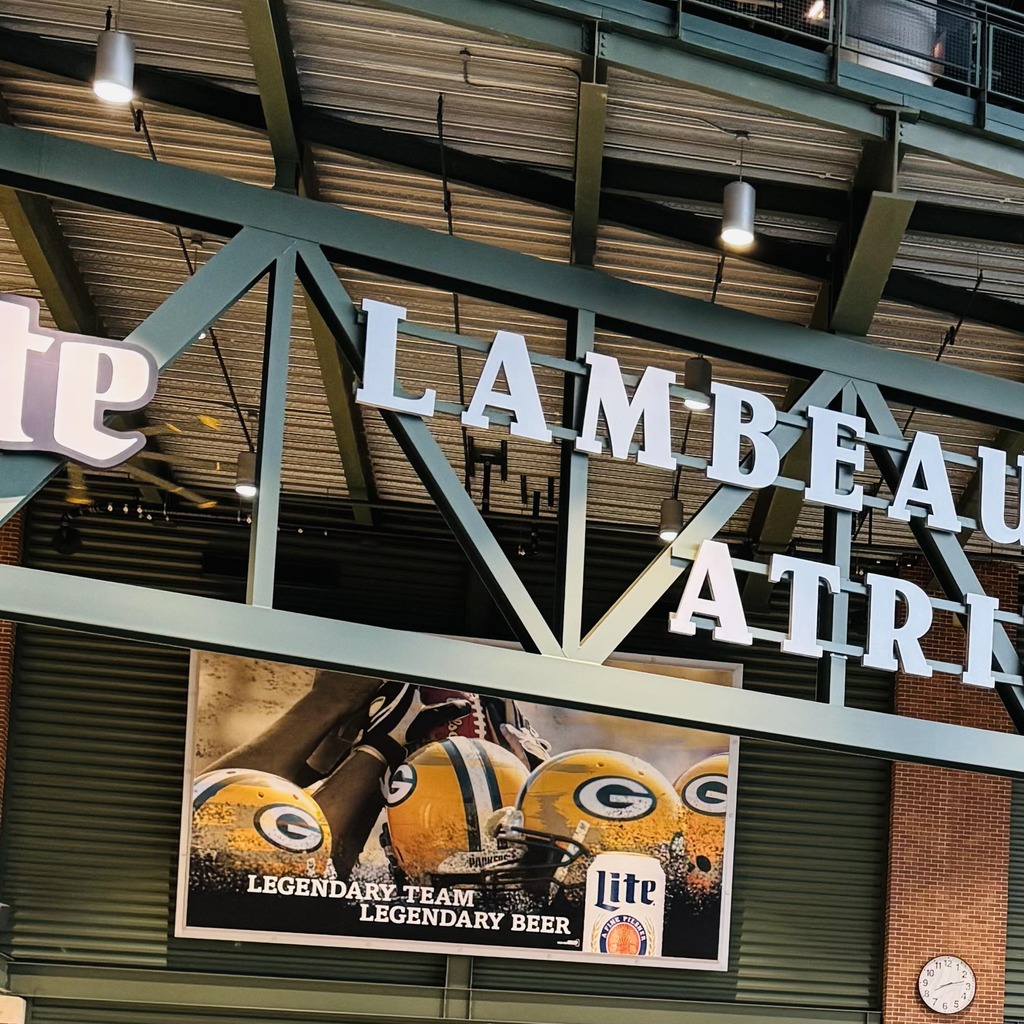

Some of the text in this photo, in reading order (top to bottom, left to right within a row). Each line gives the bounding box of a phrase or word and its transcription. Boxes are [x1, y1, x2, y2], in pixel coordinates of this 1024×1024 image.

[247, 874, 476, 907] LEGENDARY TEAM
[595, 870, 657, 912] Lite
[359, 903, 572, 935] LEGENDARY BEER
[956, 963, 960, 971] 1
[926, 969, 935, 977] 10
[962, 970, 968, 979] 2
[922, 979, 929, 987] 9
[965, 983, 971, 991] 3
[924, 990, 930, 998] 8
[961, 992, 967, 1000] 4
[932, 998, 938, 1006] 7
[942, 1002, 948, 1010] 6
[954, 1000, 959, 1008] 5
